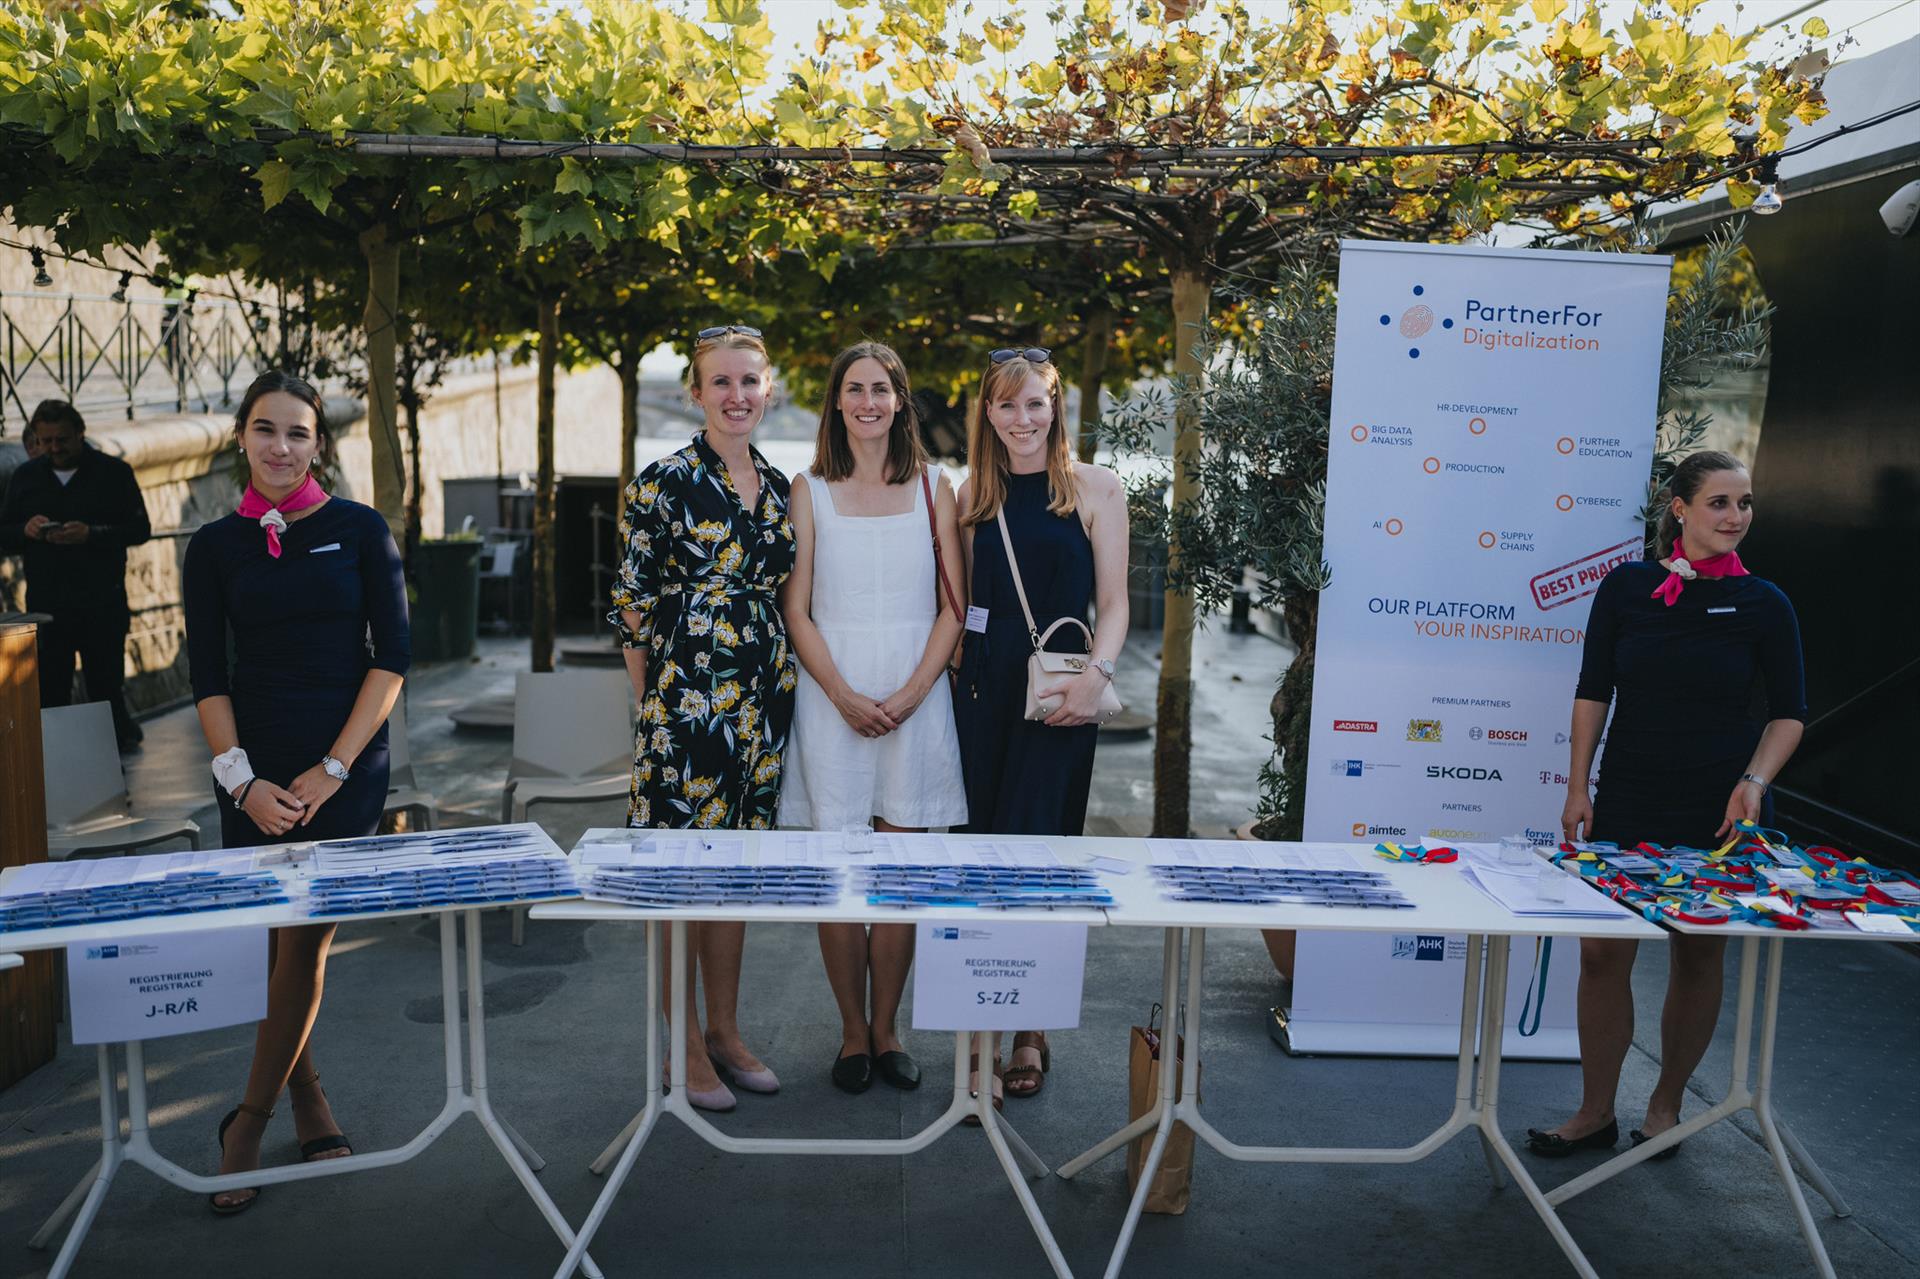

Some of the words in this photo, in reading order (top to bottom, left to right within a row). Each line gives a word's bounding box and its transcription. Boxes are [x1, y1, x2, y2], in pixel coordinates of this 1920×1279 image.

[1466, 299, 1602, 327] PartnerFor
[1463, 327, 1599, 351] Digitalization
[1437, 403, 1519, 415] HR-DEVELOPMENT
[1371, 425, 1387, 434] BIG
[1388, 426, 1412, 435] DATA
[1370, 436, 1413, 446] ANALYSIS
[1579, 437, 1620, 447] FURTHER
[1578, 448, 1633, 459] EDUCATION
[1445, 463, 1505, 474] PRODUCTION
[1576, 496, 1622, 507] CYBERSEC
[1373, 521, 1382, 529] AI
[1501, 531, 1534, 541] SUPPLY
[1500, 543, 1535, 552] CHAINS
[1538, 574, 1575, 601] BEST
[1368, 597, 1410, 615] OUR
[1415, 600, 1515, 621] PLATFORM
[1414, 620, 1465, 638] YOUR
[1431, 696, 1469, 706] PREMIUM
[1471, 699, 1512, 708] PARTNERS
[1337, 722, 1376, 731] ADASTRA
[1488, 729, 1528, 741] BOSCH
[1441, 803, 1483, 813] PARTNERS
[1368, 824, 1407, 836] aimtec
[1418, 939, 1443, 950] AHK
[965, 959, 1037, 968] REGISTRIERUNG
[129, 969, 213, 985] REGISTRIERUNG
[972, 969, 1028, 978] REGISTRACE
[139, 980, 204, 993] REGISTRACE
[977, 989, 1020, 1004] S-Z/Ž
[145, 998, 198, 1018] J-R/Ř
